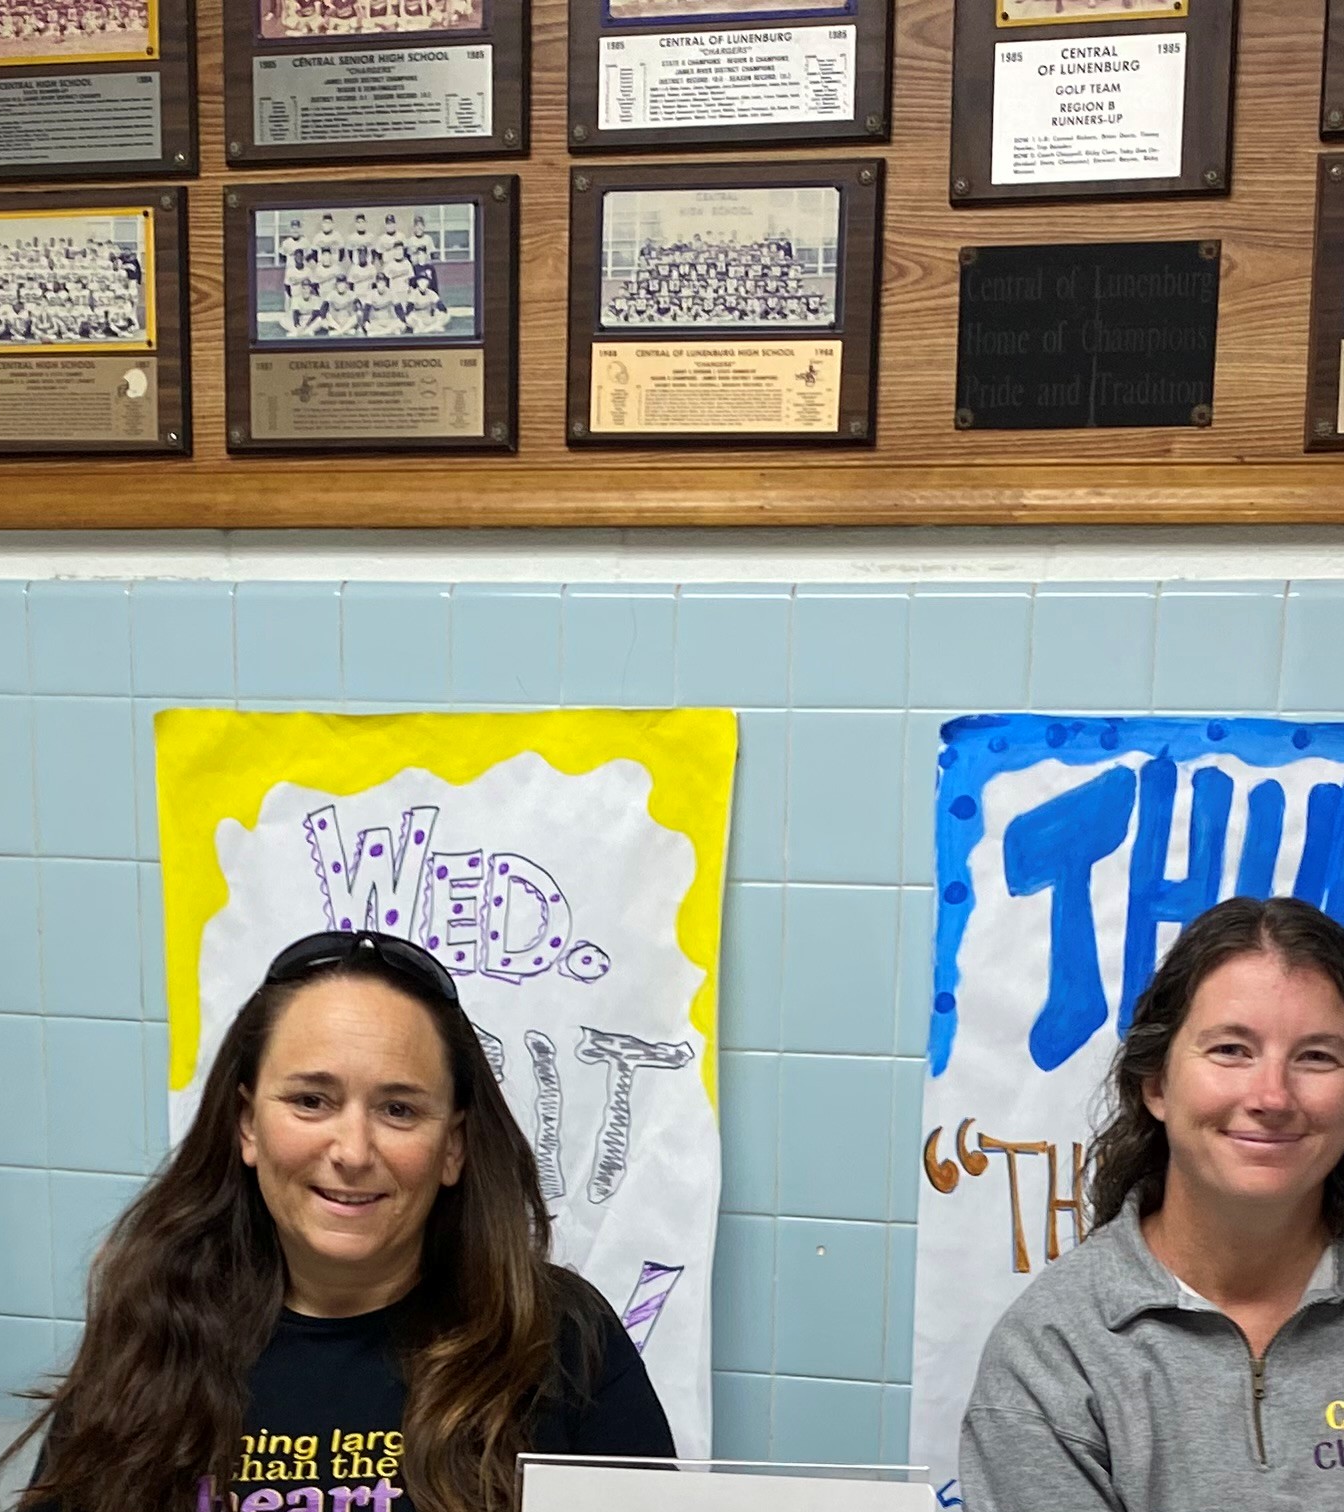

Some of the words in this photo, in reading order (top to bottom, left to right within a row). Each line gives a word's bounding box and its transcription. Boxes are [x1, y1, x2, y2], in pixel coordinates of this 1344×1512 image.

[659, 37, 706, 48] CENTRAL
[708, 36, 724, 46] OF
[727, 32, 793, 44] LUNENBURG
[1061, 46, 1118, 60] CENTRAL
[1157, 43, 1181, 54] 1985
[292, 57, 335, 68] CENTRAL
[338, 55, 375, 66] SENIOR
[408, 51, 449, 62] SCHOOL
[1000, 52, 1023, 62] 1985
[1037, 65, 1056, 76] OF
[1060, 60, 1141, 75] LUNENBURG
[1055, 84, 1086, 96] GOLF
[1090, 83, 1121, 94] TEAM
[1060, 101, 1104, 113] REGION
[1107, 100, 1115, 111] B
[1051, 114, 1123, 126] RUNNERS-UP
[966, 266, 1043, 302] Central
[967, 321, 1030, 357] Home
[302, 805, 611, 984] WED.
[330, 1451, 398, 1479] the
